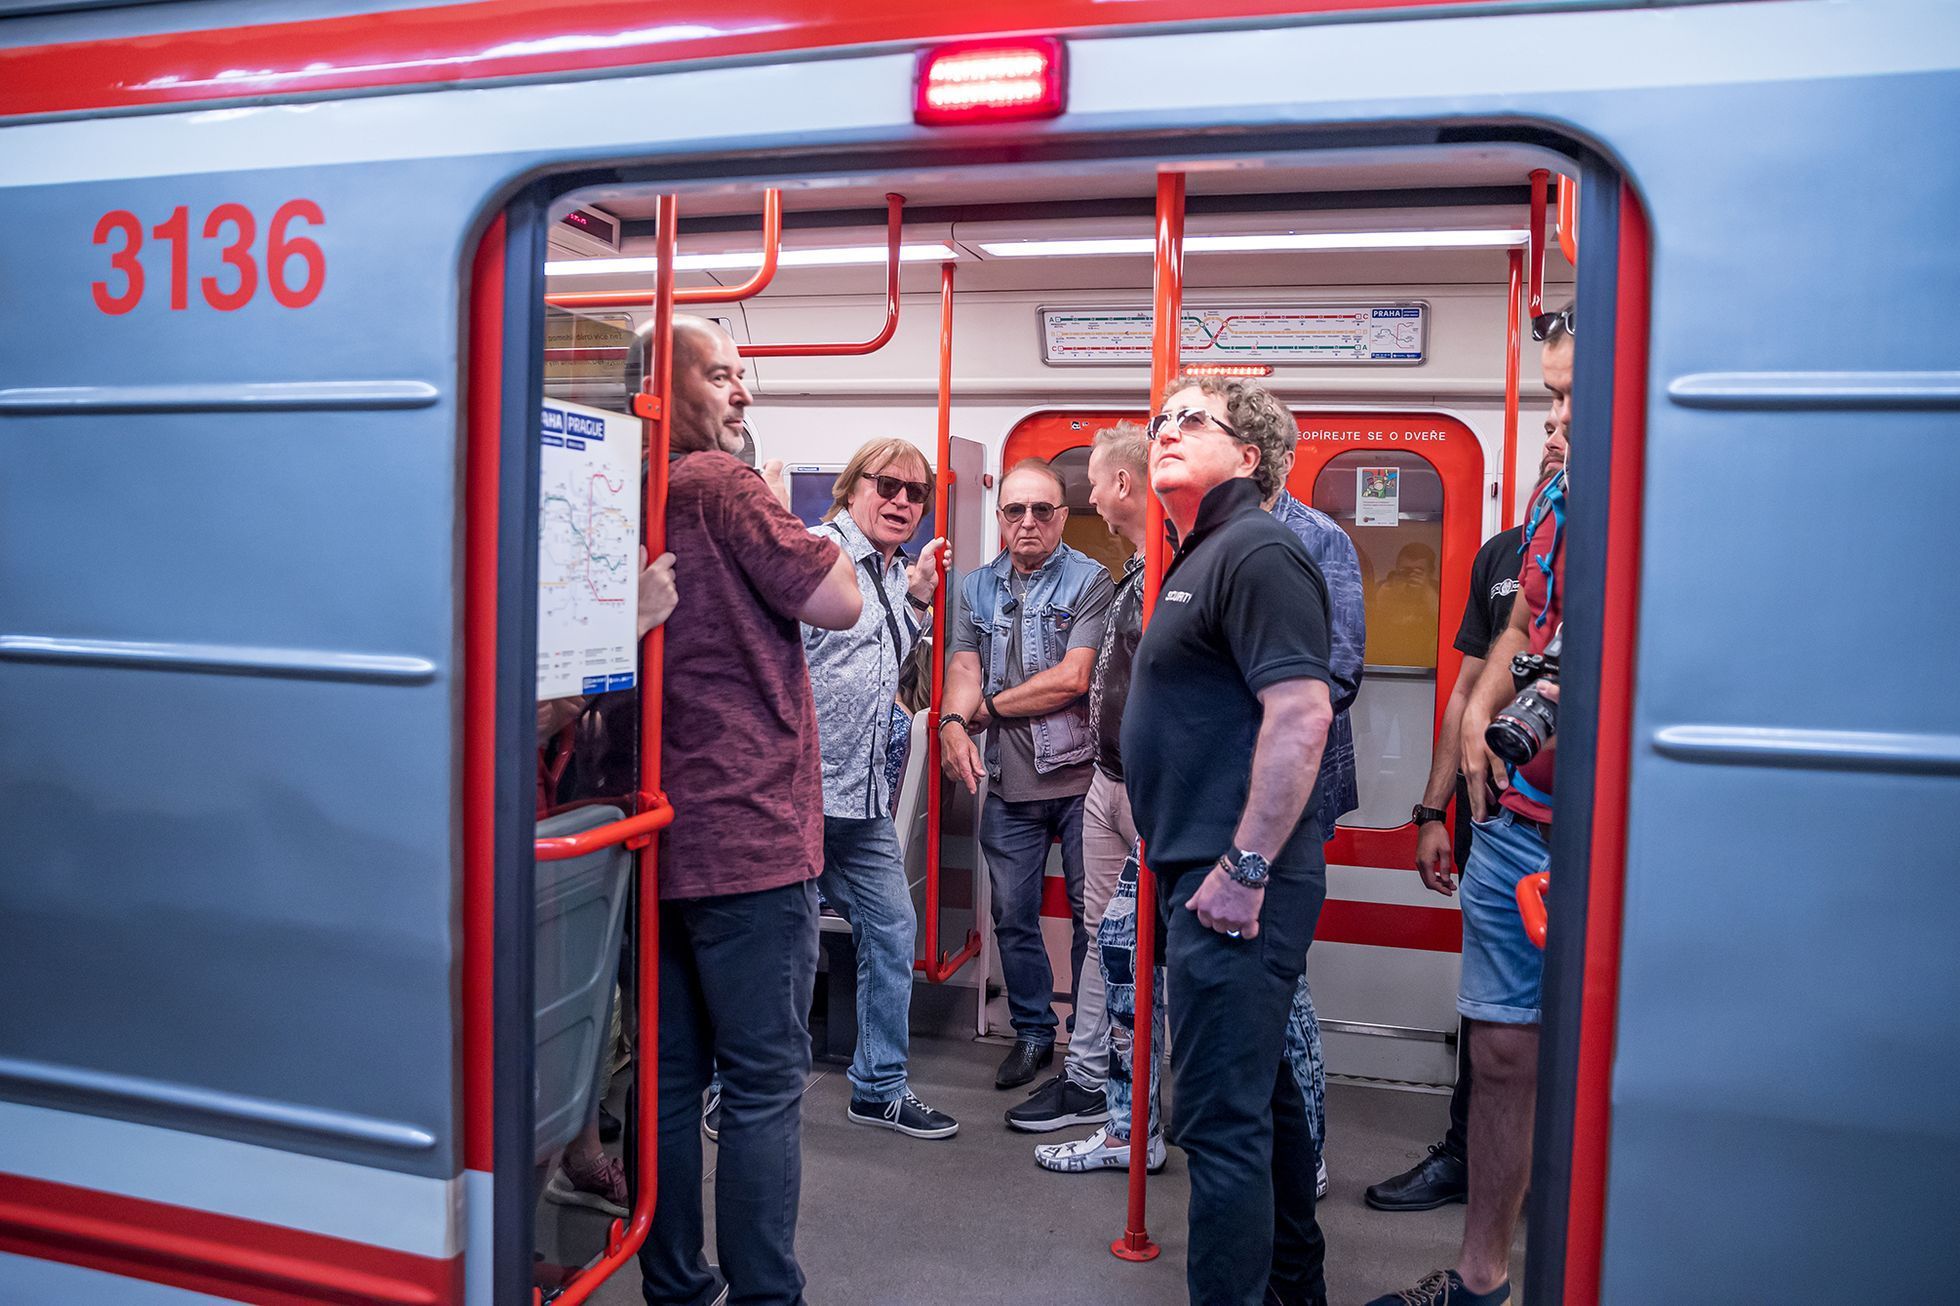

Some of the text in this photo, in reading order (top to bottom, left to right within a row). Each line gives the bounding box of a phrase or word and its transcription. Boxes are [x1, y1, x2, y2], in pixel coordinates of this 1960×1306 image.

[91, 197, 327, 316] 3136
[542, 410, 604, 437] AHA PRAGUE
[1296, 429, 1446, 441] EOPÍREJTE SE O DVEŘE
